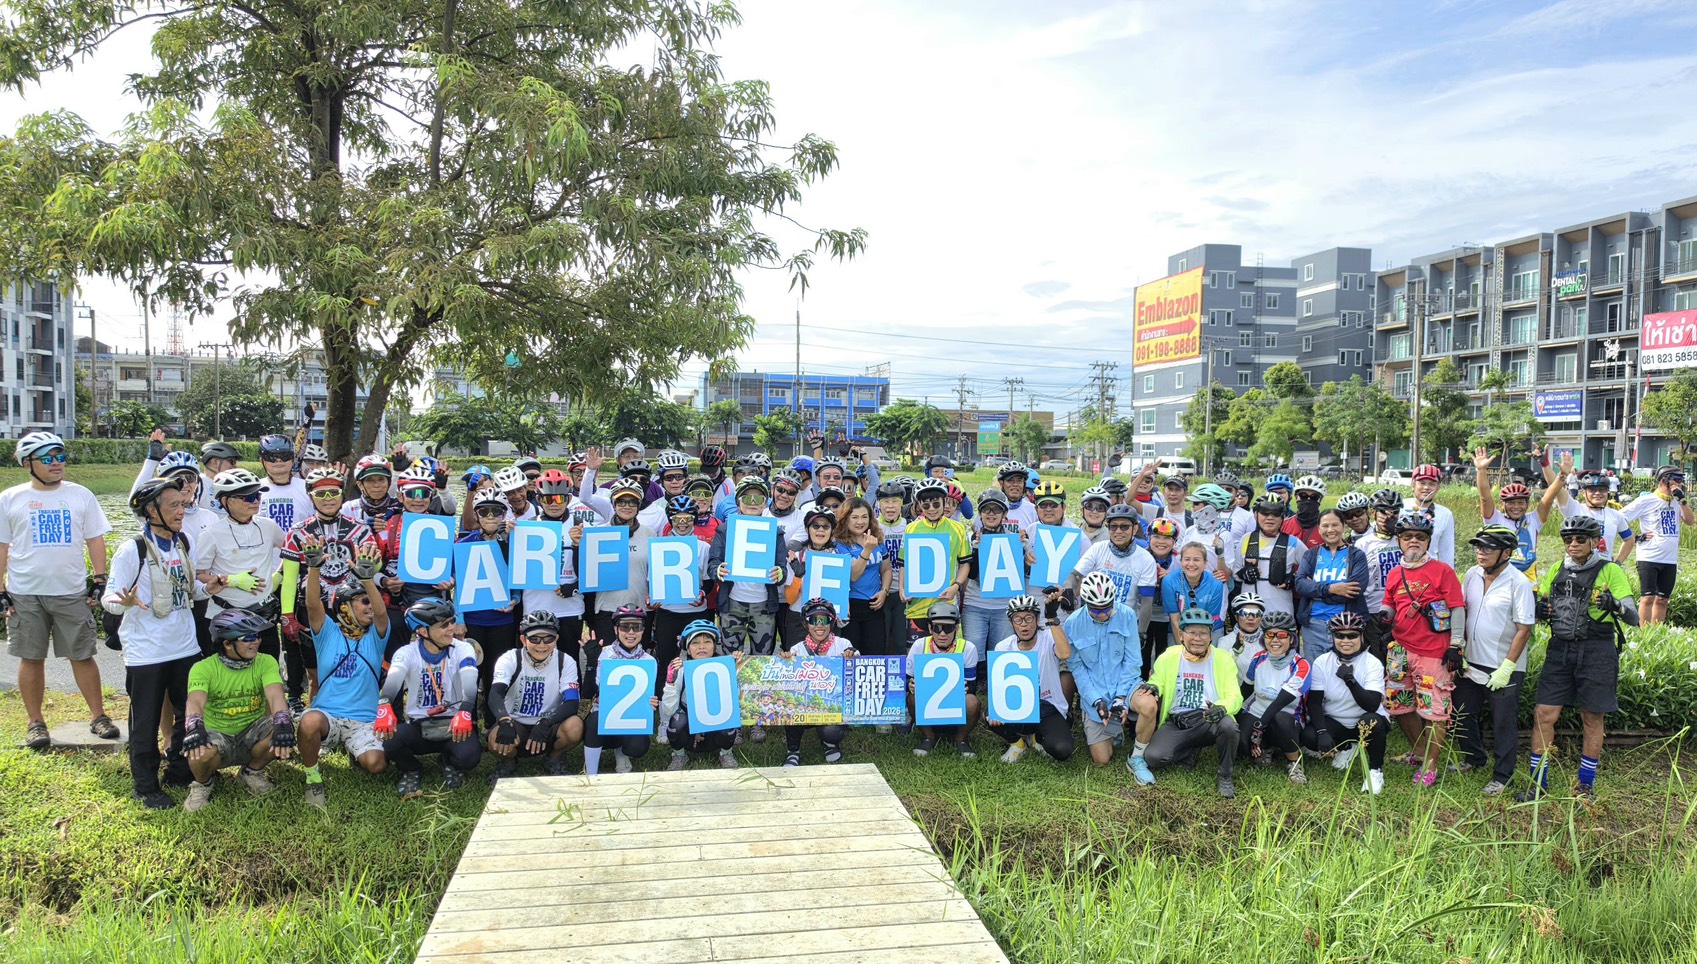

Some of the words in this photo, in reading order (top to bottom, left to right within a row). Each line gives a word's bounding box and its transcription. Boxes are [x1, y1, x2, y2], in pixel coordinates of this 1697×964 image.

[1551, 276, 1576, 287] DENTAL
[1137, 293, 1199, 327] Emblazon
[1645, 317, 1697, 347] ให้เช่า
[1136, 336, 1198, 361] 091-198-8888
[1642, 354, 1655, 365] 081
[1657, 352, 1673, 364] 823
[1675, 350, 1697, 362] 5858
[269, 503, 294, 516] CAR
[1660, 510, 1676, 520] CAR
[38, 514, 61, 524] CAR
[269, 515, 294, 528] REE
[38, 523, 62, 534] FREE
[1662, 526, 1677, 535] DAY
[39, 533, 63, 544] DAY
[1378, 550, 1403, 564] CAR
[855, 658, 886, 666] BANGKOK
[855, 665, 886, 682] CAR
[524, 681, 546, 694] CAR
[855, 681, 886, 699] FREE
[1183, 678, 1205, 691] CAR
[522, 692, 545, 707] FREE
[1182, 689, 1204, 704] FREE
[519, 703, 543, 717] DAY
[854, 698, 885, 716] DAY
[883, 706, 901, 715] 2026
[794, 714, 805, 723] 20
